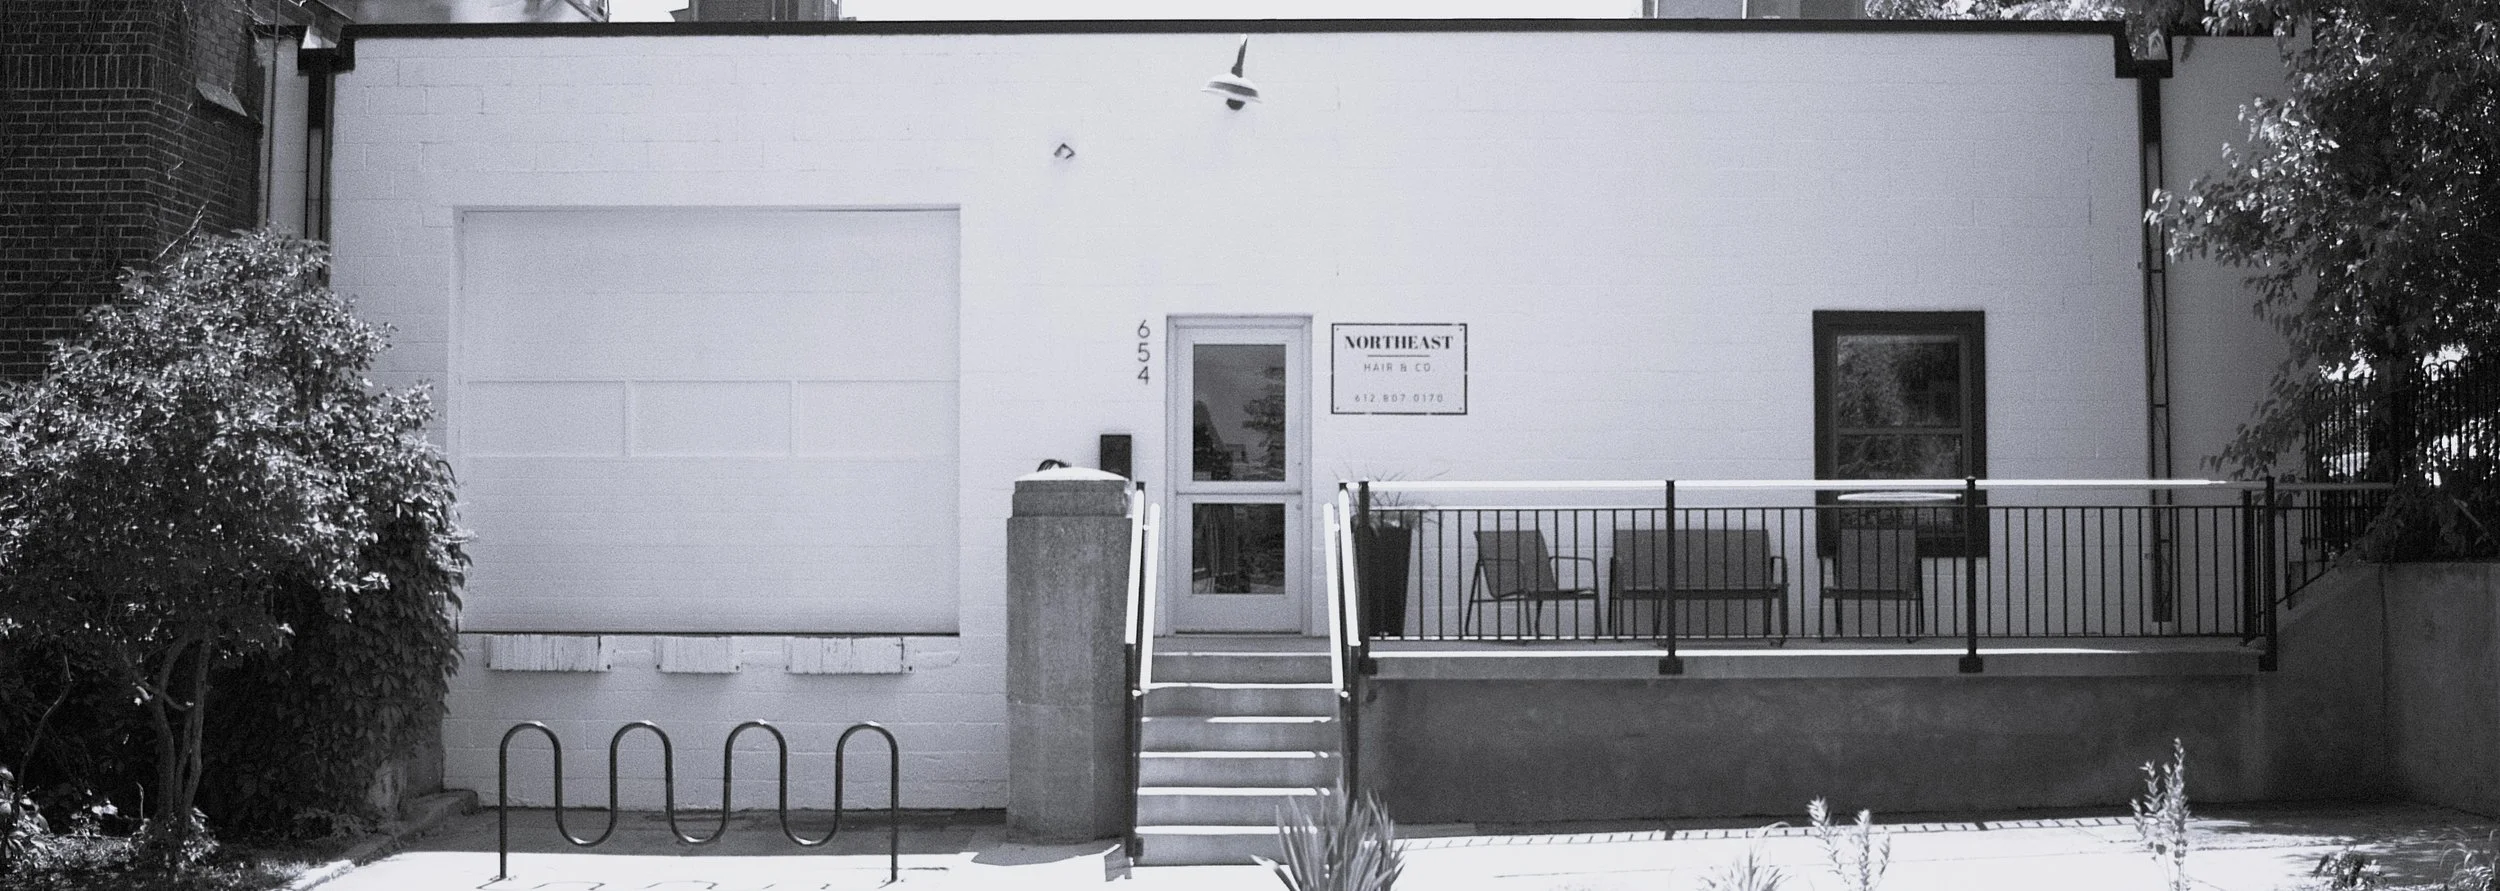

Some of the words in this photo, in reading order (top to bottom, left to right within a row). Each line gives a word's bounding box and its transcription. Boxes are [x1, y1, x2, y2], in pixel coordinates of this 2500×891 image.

[1345, 335, 1453, 349] NORTHEAST
[1137, 319, 1151, 385] 654
[1364, 363, 1393, 372] HAIR
[1400, 363, 1407, 372] &
